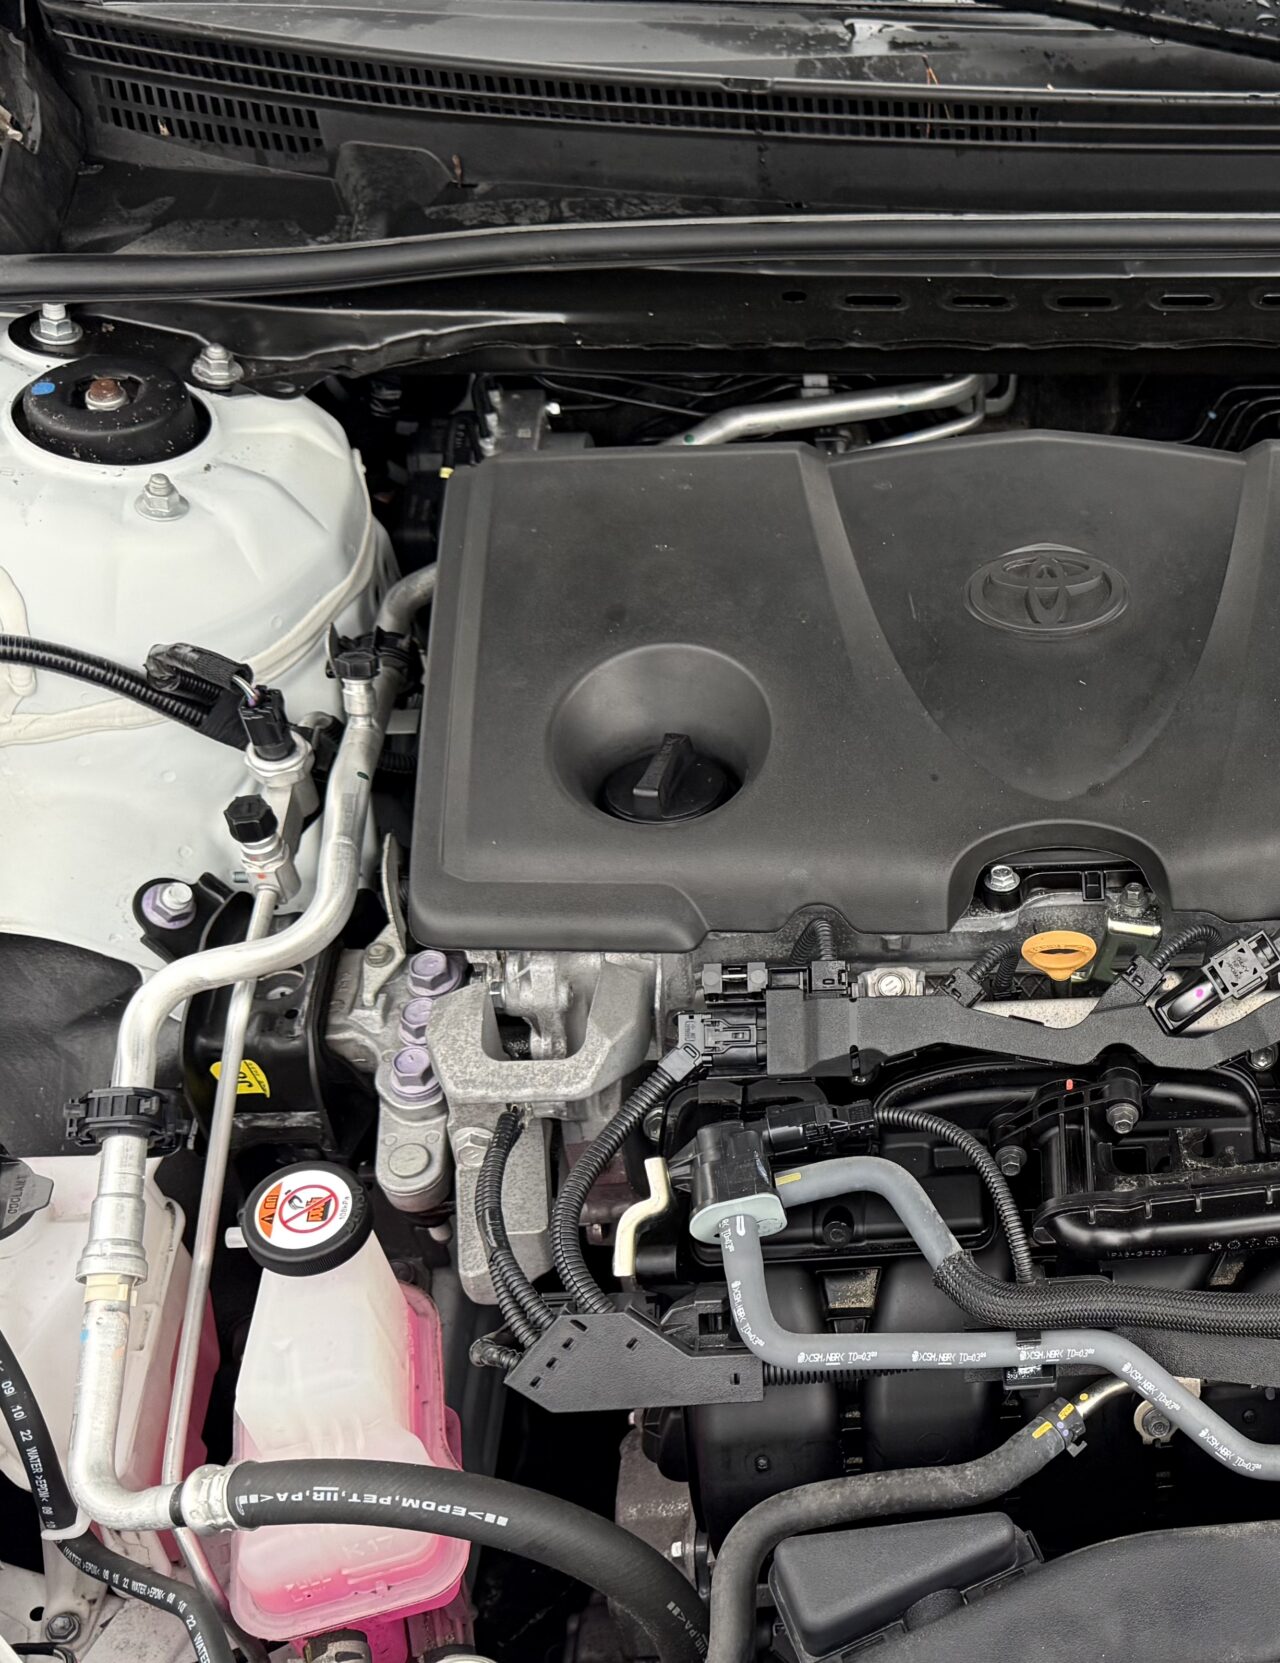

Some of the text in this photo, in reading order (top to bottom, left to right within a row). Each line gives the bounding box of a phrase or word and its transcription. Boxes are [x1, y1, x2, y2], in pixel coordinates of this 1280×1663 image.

[20, 1429, 33, 1442] 22
[26, 1446, 43, 1478] WATER
[63, 1546, 82, 1566] WATER
[131, 1581, 147, 1595] WATER
[185, 1615, 197, 1630] 22
